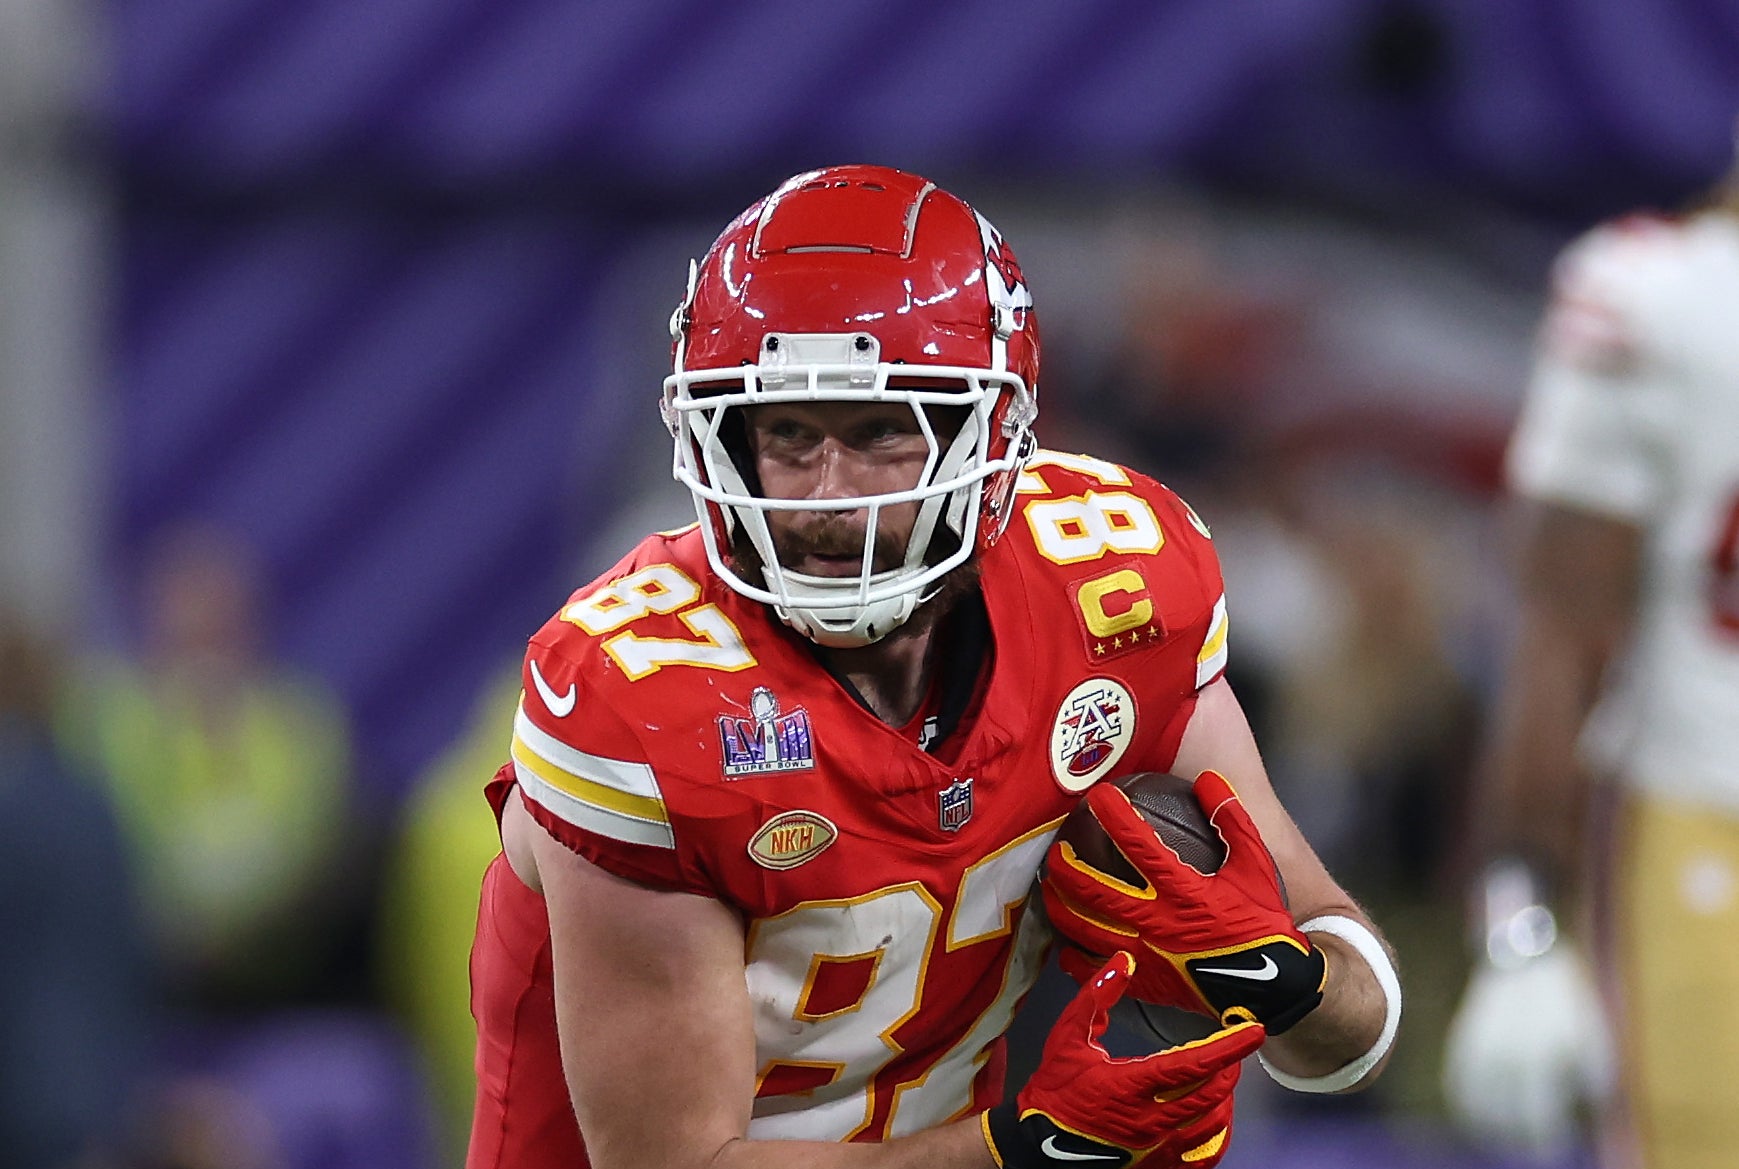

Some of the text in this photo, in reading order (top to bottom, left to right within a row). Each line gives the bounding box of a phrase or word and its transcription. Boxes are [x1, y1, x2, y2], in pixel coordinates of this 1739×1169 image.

[1015, 449, 1166, 566] 87
[560, 563, 759, 682] 87
[1077, 569, 1153, 638] C
[734, 760, 807, 774] SUPER BOWL
[770, 825, 815, 855] NKH
[743, 812, 1070, 1143] 87
